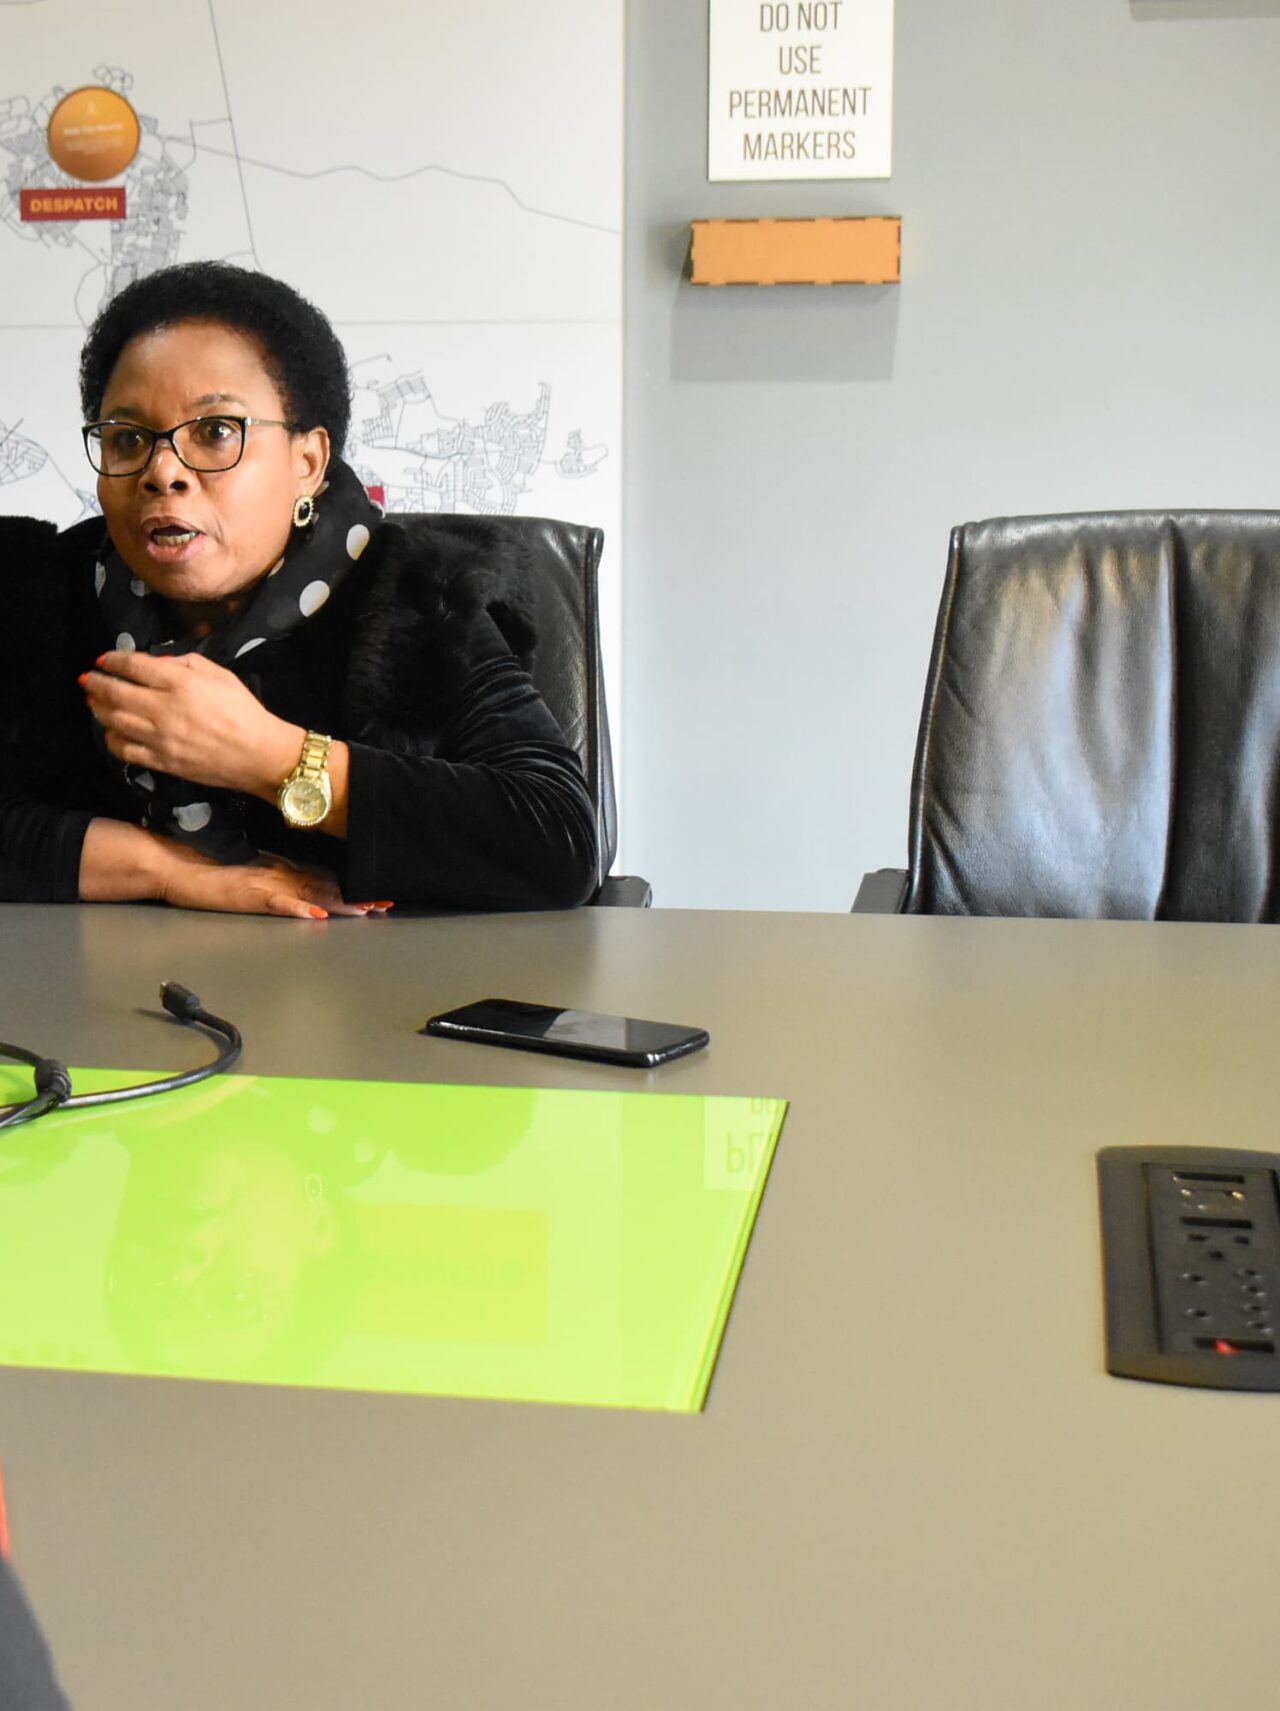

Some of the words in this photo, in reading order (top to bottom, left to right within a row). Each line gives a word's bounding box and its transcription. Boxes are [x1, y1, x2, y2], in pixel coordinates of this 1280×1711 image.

[760, 2, 789, 32] DO
[797, 1, 843, 30] NOT
[779, 45, 823, 75] USE
[729, 87, 872, 119] PERMANENT
[743, 131, 856, 161] MARKERS
[30, 196, 118, 213] DESPATCH
